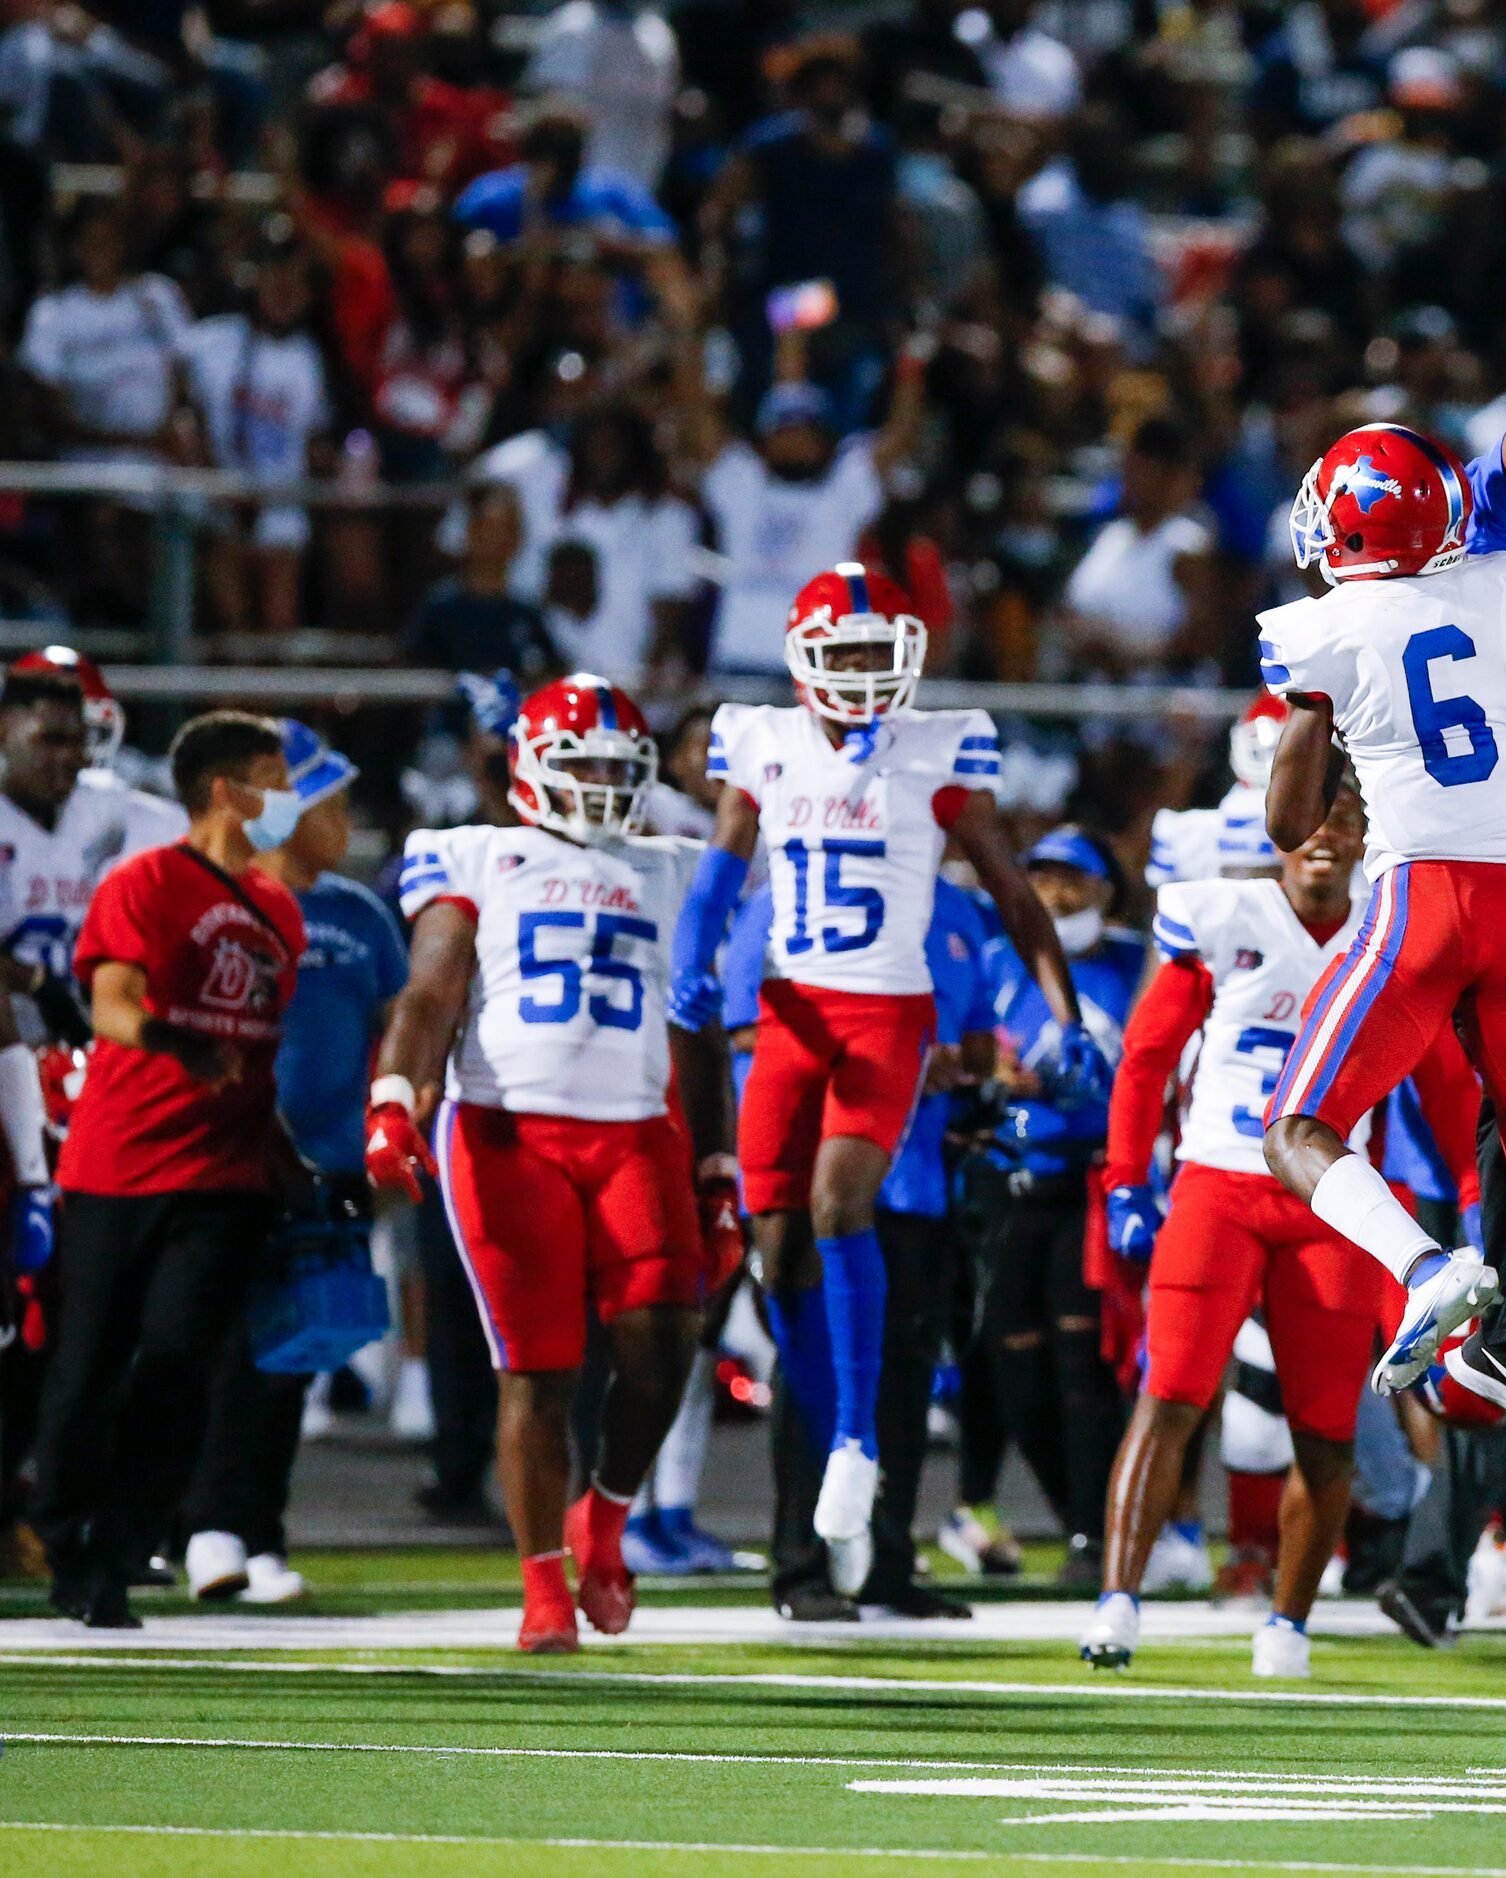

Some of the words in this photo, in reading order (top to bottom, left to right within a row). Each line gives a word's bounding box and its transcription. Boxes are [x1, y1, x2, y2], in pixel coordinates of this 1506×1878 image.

[1402, 624, 1499, 787] 6
[783, 838, 886, 955] 15
[518, 911, 658, 1031] 55
